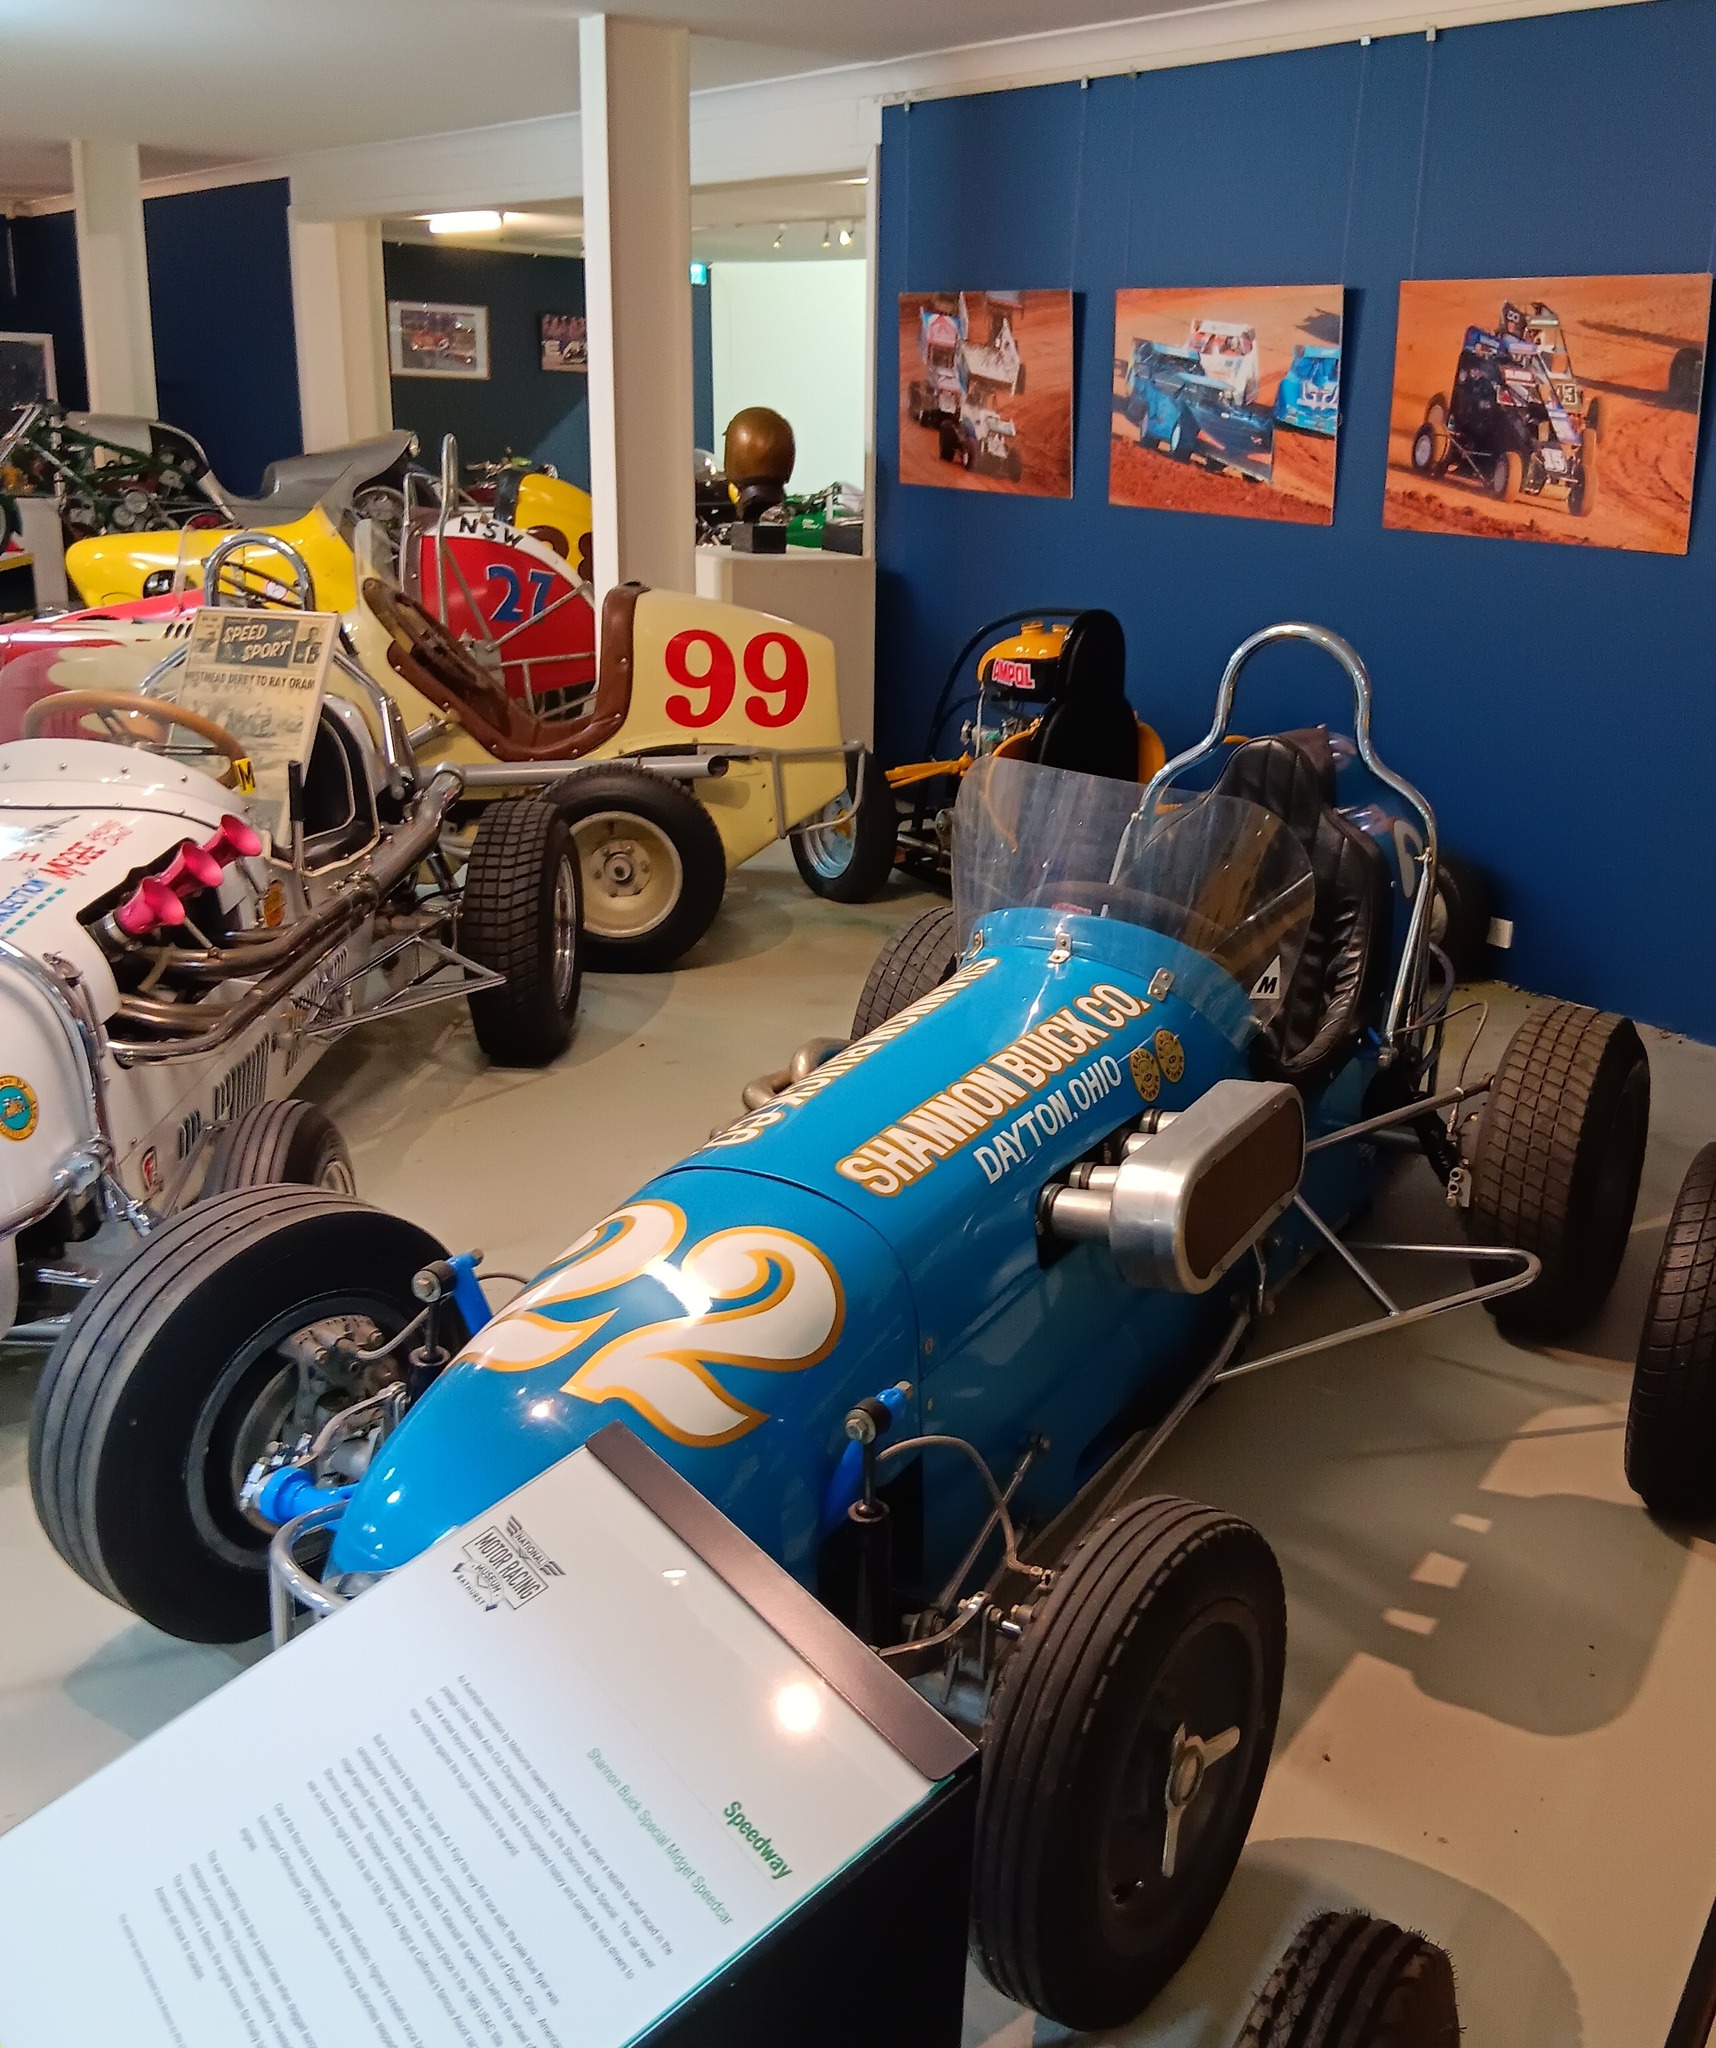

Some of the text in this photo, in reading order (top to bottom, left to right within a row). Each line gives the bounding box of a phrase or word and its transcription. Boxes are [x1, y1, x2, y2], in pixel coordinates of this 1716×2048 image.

[459, 516, 525, 547] NSW
[486, 564, 557, 624] 27
[221, 624, 268, 643] SPEED
[241, 640, 292, 662] SPORT
[664, 629, 809, 728] 99
[992, 658, 1036, 690] AMPOL
[238, 760, 256, 791] M
[1257, 976, 1278, 994] M
[837, 983, 1151, 1197] SHANNON BUICK CO.
[973, 1055, 1122, 1184] DAYTON, OHIO
[441, 1199, 846, 1448] 22
[515, 1533, 544, 1565] NATIONAL
[474, 1531, 542, 1600] MOTOR RACING
[474, 1564, 502, 1593] MUSEUM
[456, 1574, 486, 1605] BATHURST
[587, 1747, 735, 1927] Shannon Buick Special Midget Speedcar
[722, 1800, 794, 1881] Speedway
